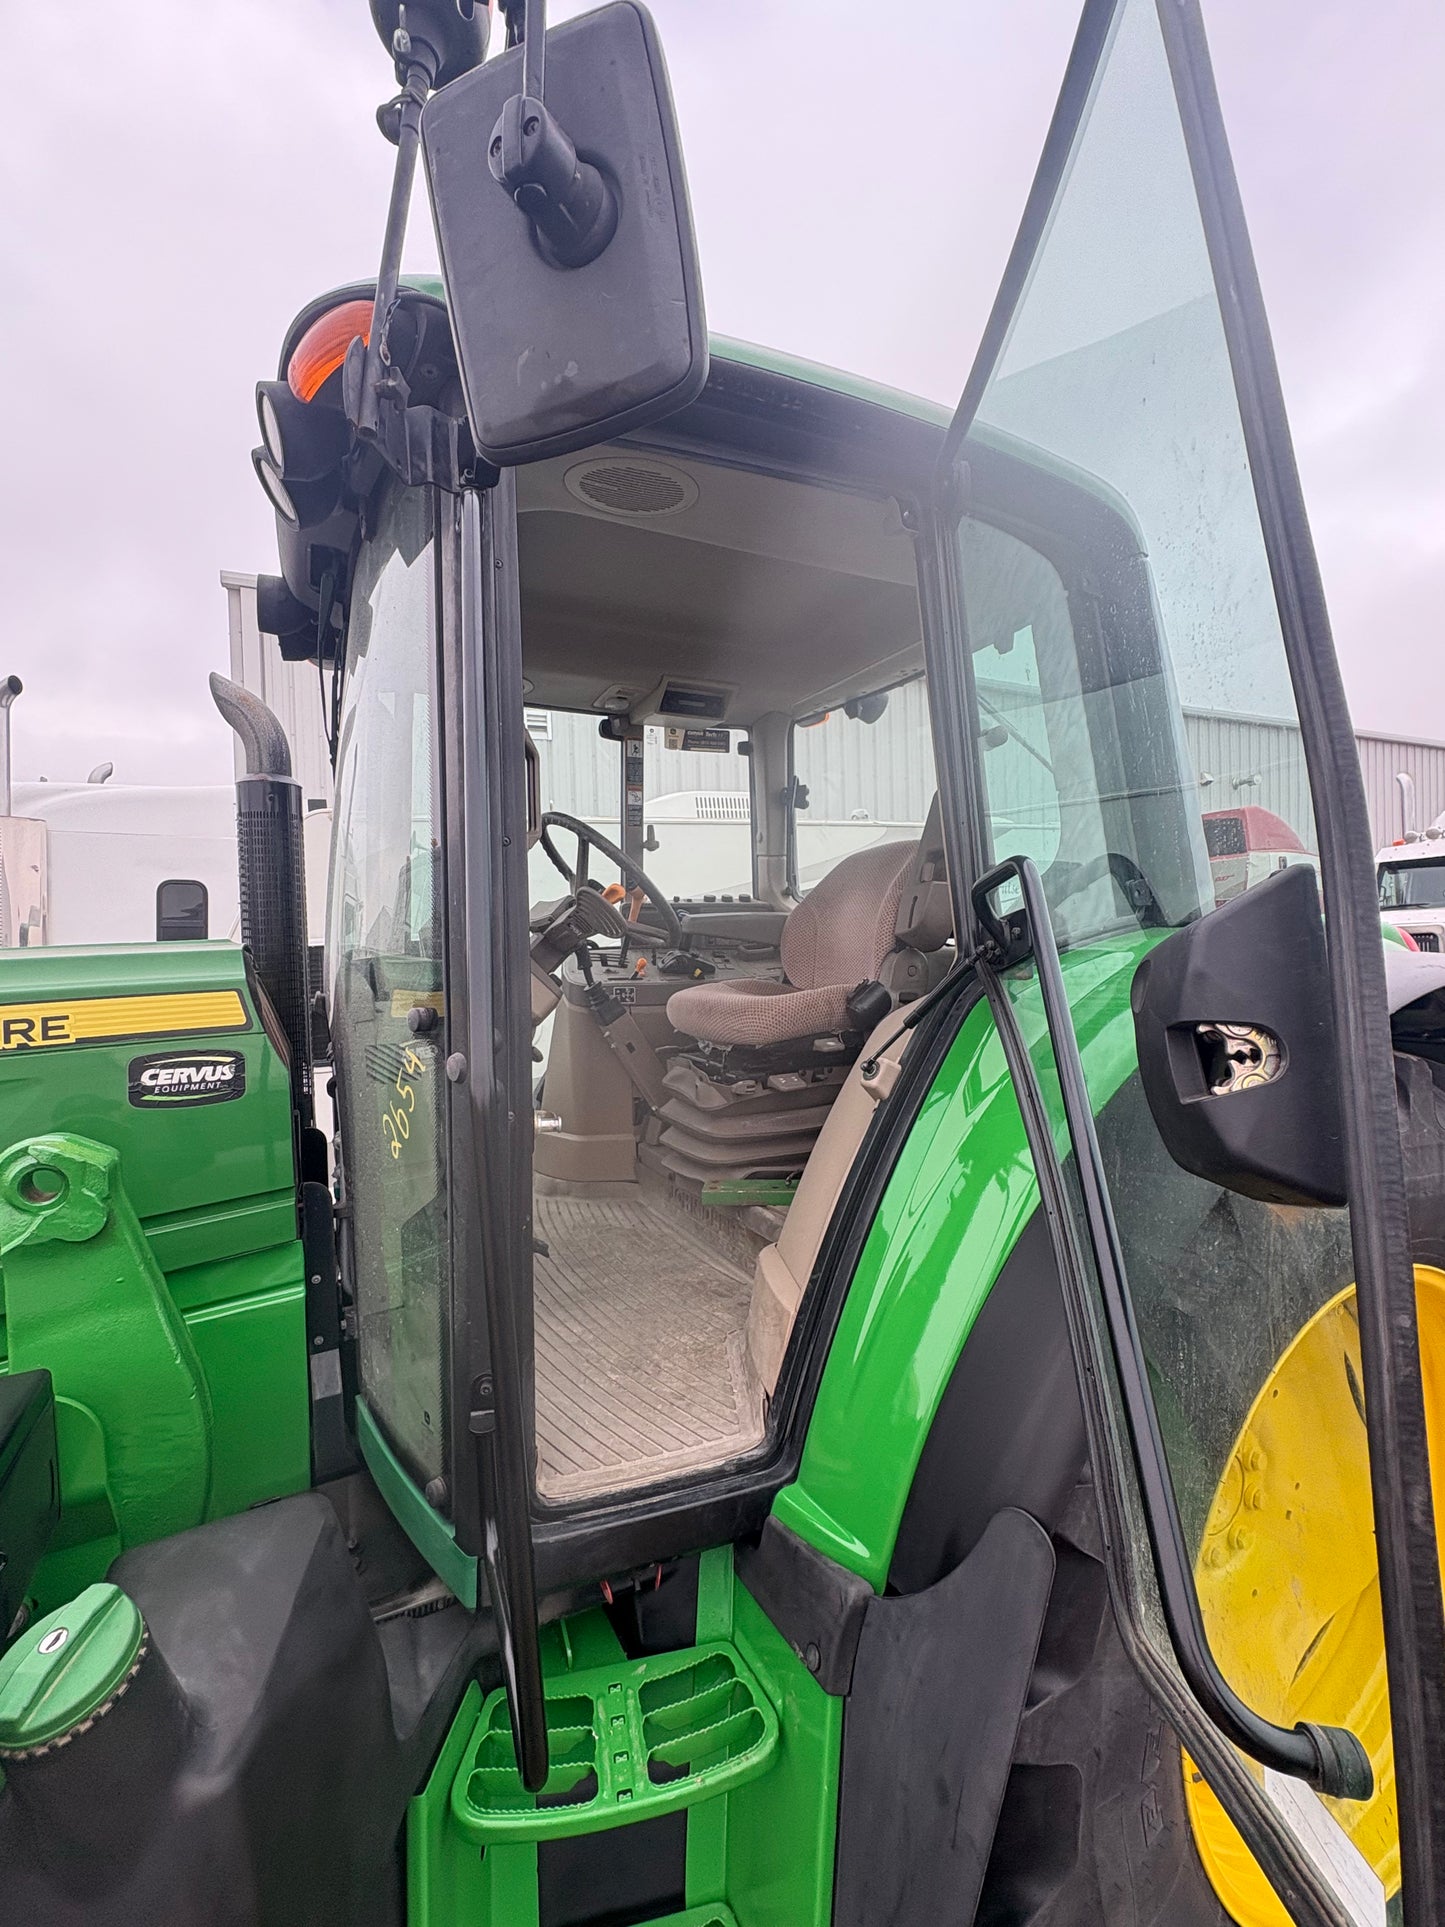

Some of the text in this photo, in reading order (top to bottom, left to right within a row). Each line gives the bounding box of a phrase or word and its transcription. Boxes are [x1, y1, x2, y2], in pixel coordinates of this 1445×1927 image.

[3, 1015, 71, 1045] RE
[140, 1064, 236, 1086] CERVUS
[154, 1082, 221, 1094] EQUIPMENT
